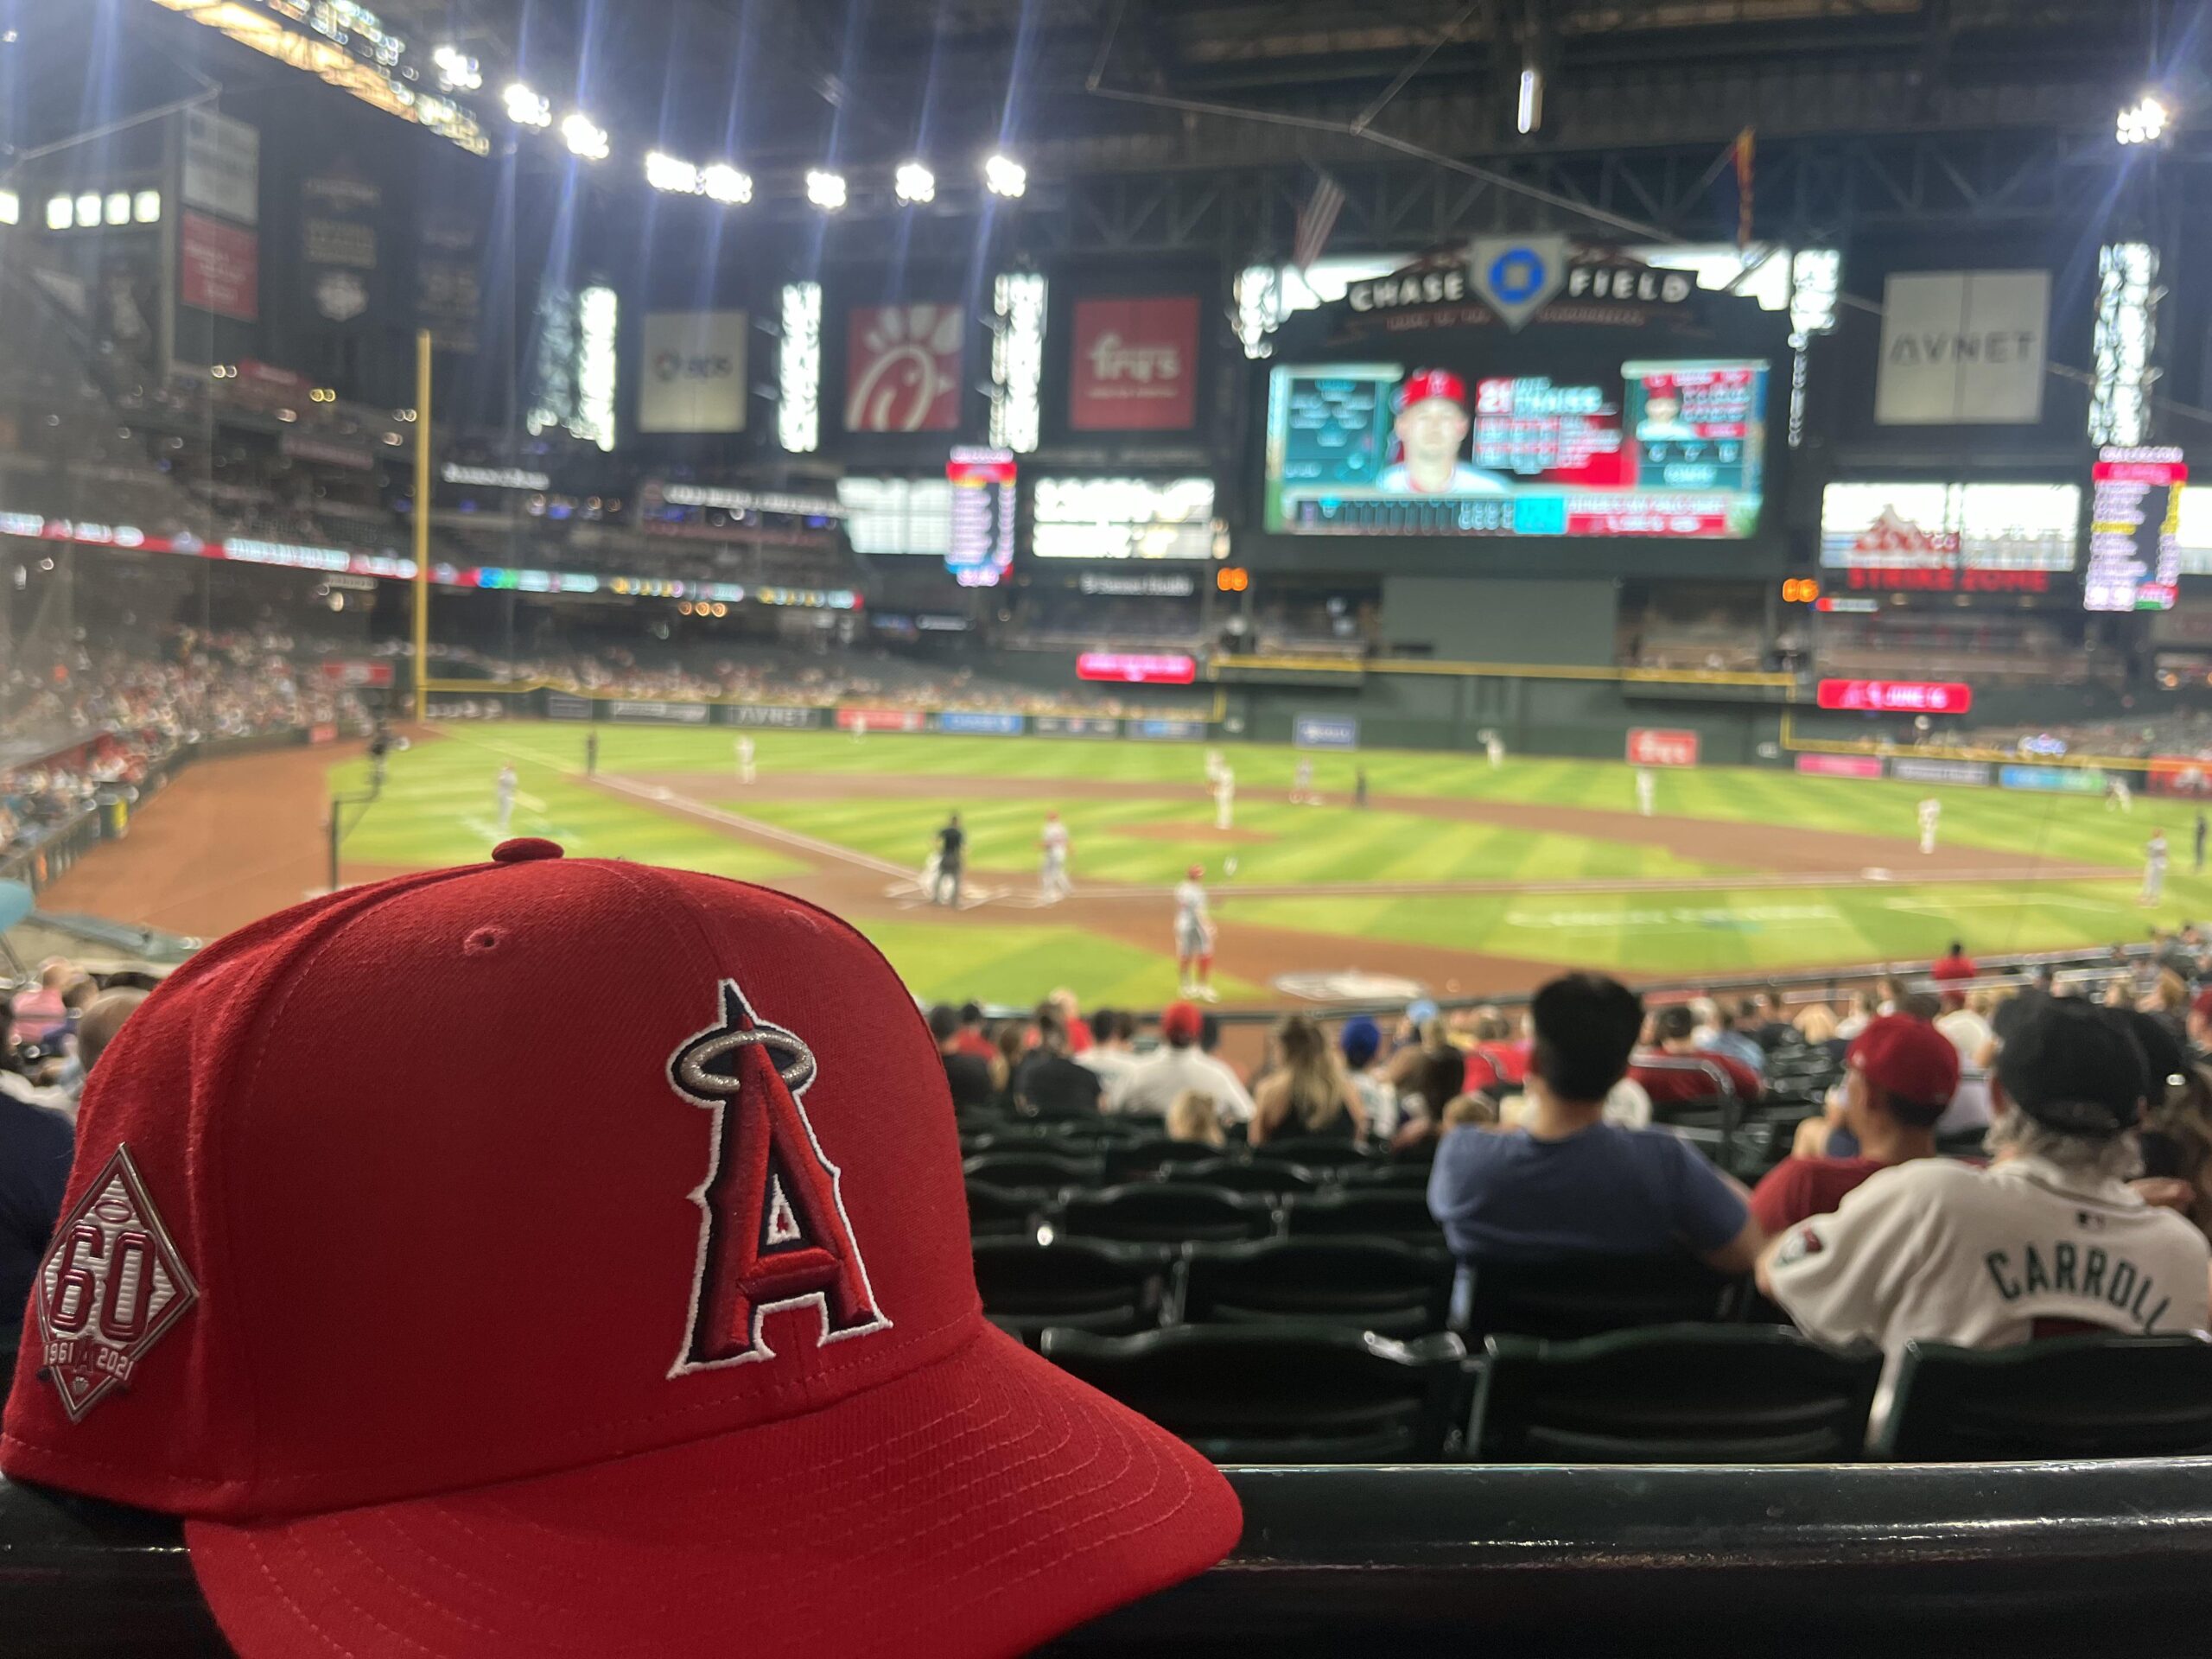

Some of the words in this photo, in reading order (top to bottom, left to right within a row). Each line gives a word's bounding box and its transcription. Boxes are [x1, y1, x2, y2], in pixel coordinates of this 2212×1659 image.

[1349, 271, 1465, 312] CHASE
[1568, 267, 1691, 303] FIELD
[1890, 332, 2034, 365] AVNET
[666, 978, 893, 1380] A
[49, 1224, 156, 1340] 60
[1986, 1239, 2171, 1335] CARROLL
[43, 1342, 74, 1366] 1961
[97, 1347, 134, 1381] 2021
